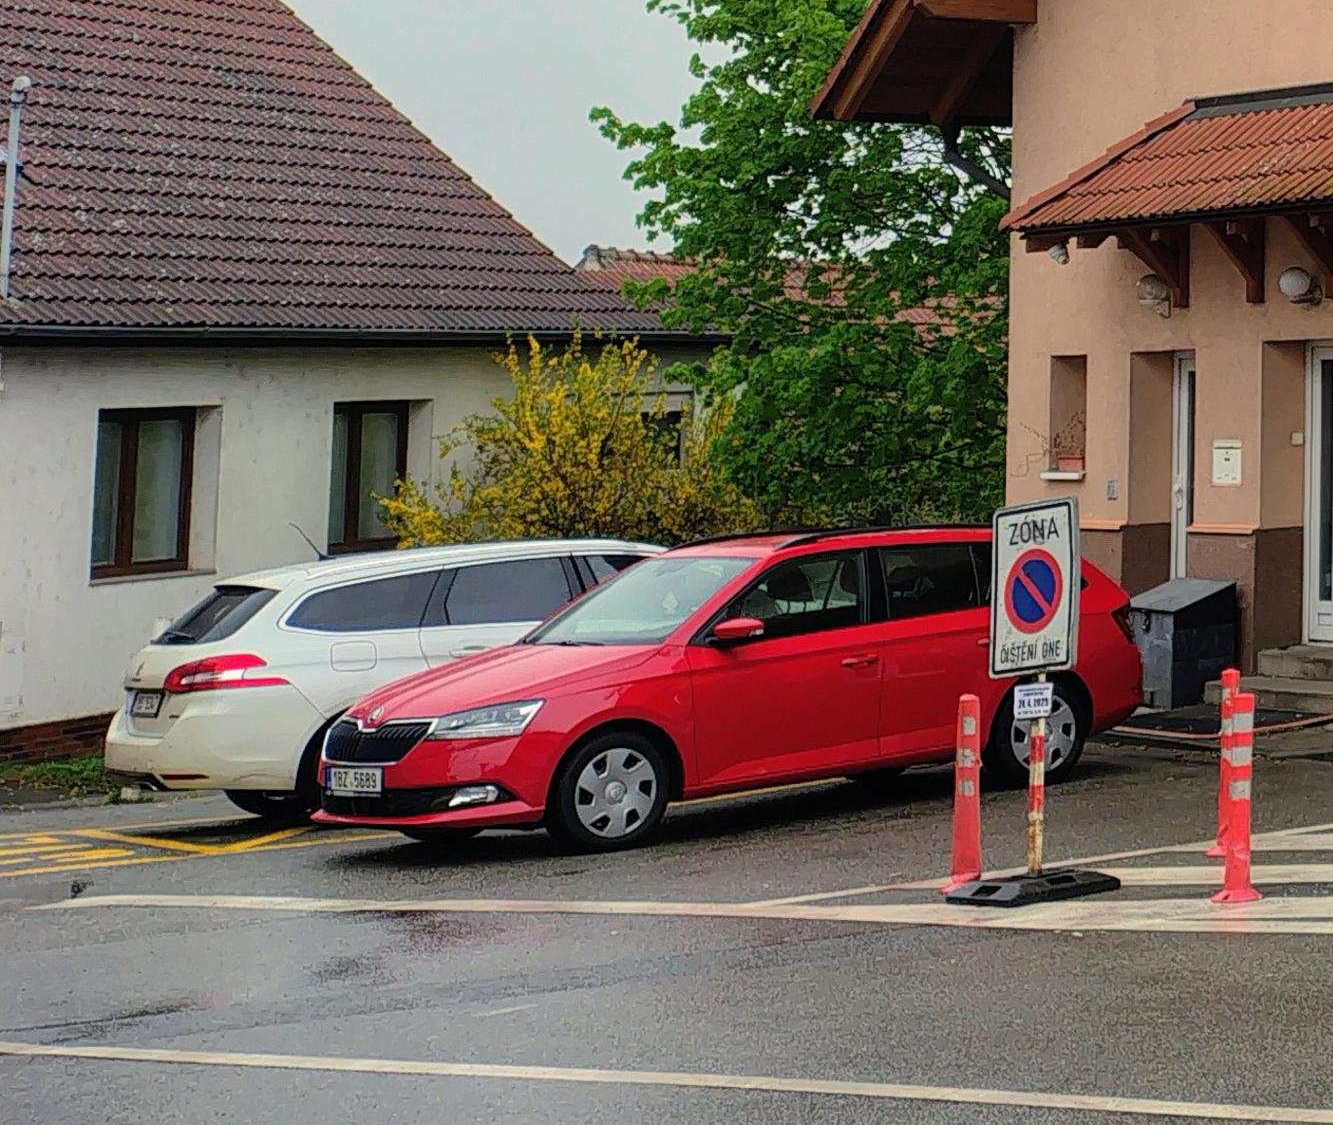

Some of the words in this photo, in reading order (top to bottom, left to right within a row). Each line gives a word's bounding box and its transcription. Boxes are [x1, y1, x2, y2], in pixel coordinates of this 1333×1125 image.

[1008, 515, 1060, 546] ZÓNA
[1000, 640, 1037, 664] ČIŠTĚNÍ
[333, 771, 348, 787] 1BZ
